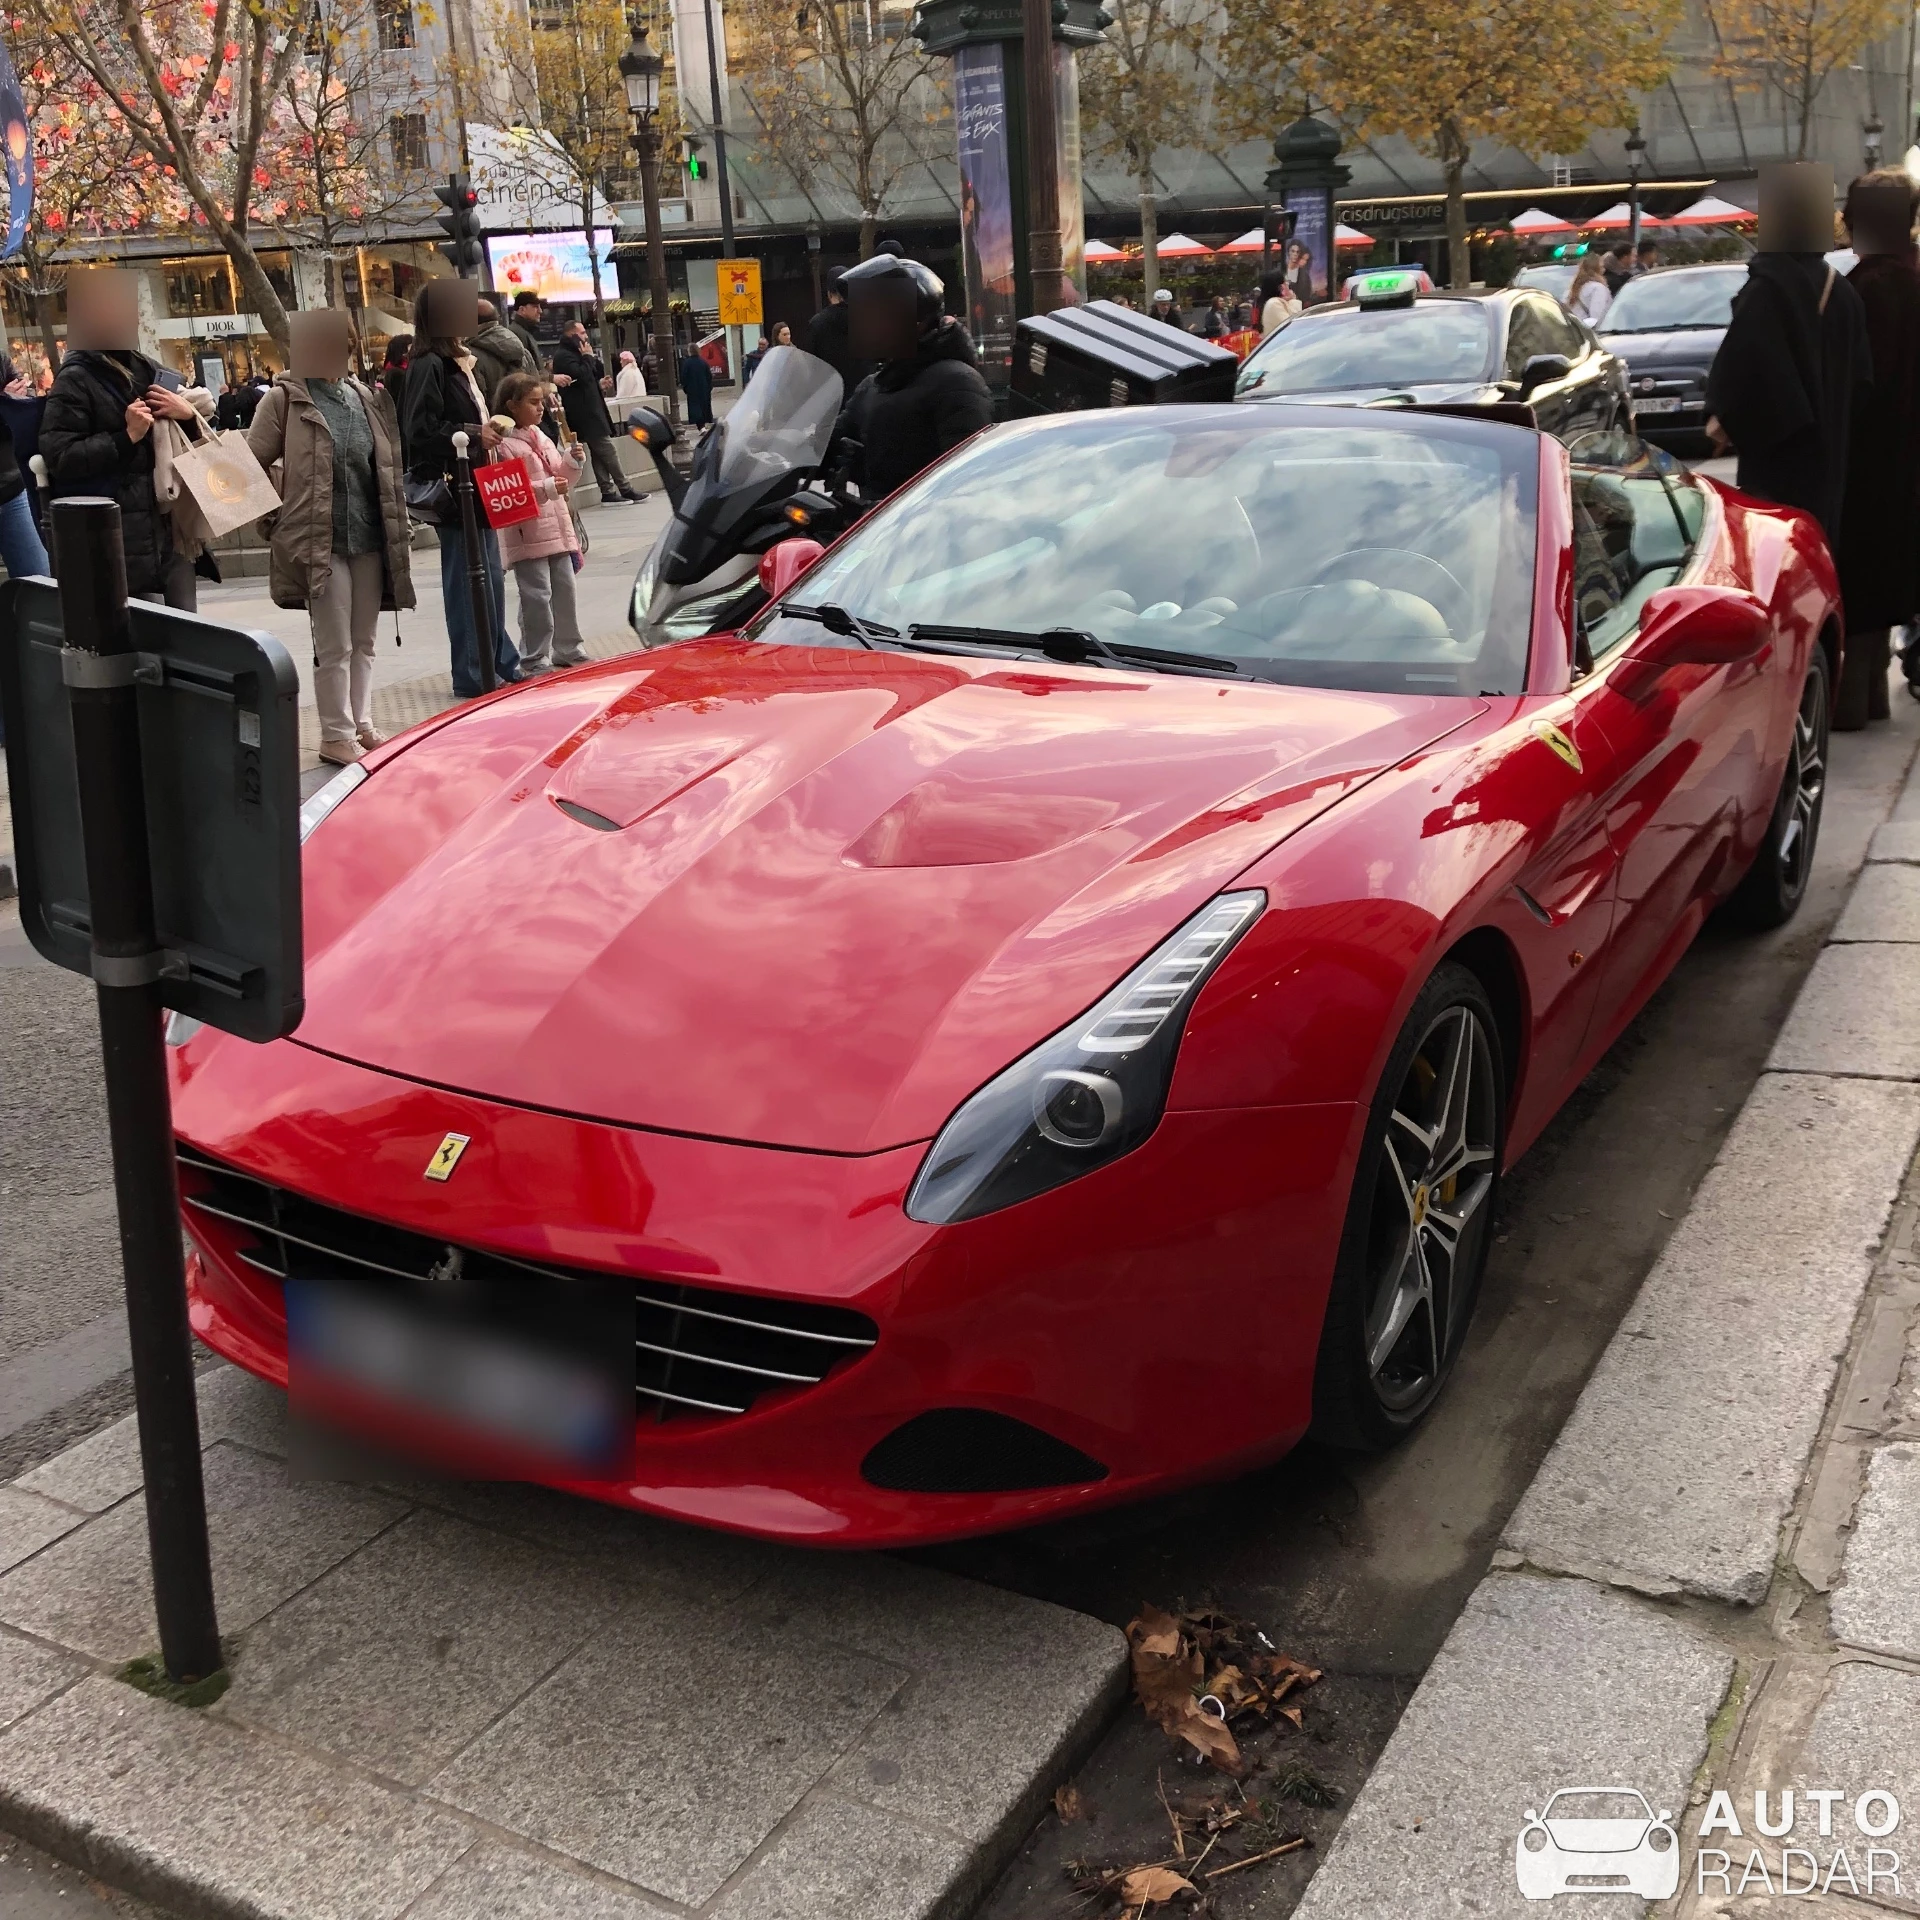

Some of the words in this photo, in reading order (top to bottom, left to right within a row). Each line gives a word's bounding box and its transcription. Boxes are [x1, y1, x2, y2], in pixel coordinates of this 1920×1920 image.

[982, 8, 1023, 19] SPECTA
[1337, 204, 1443, 223] icisdrugstore
[1368, 280, 1399, 290] TAXI
[206, 320, 235, 332] DIOR
[483, 472, 523, 495] MINI
